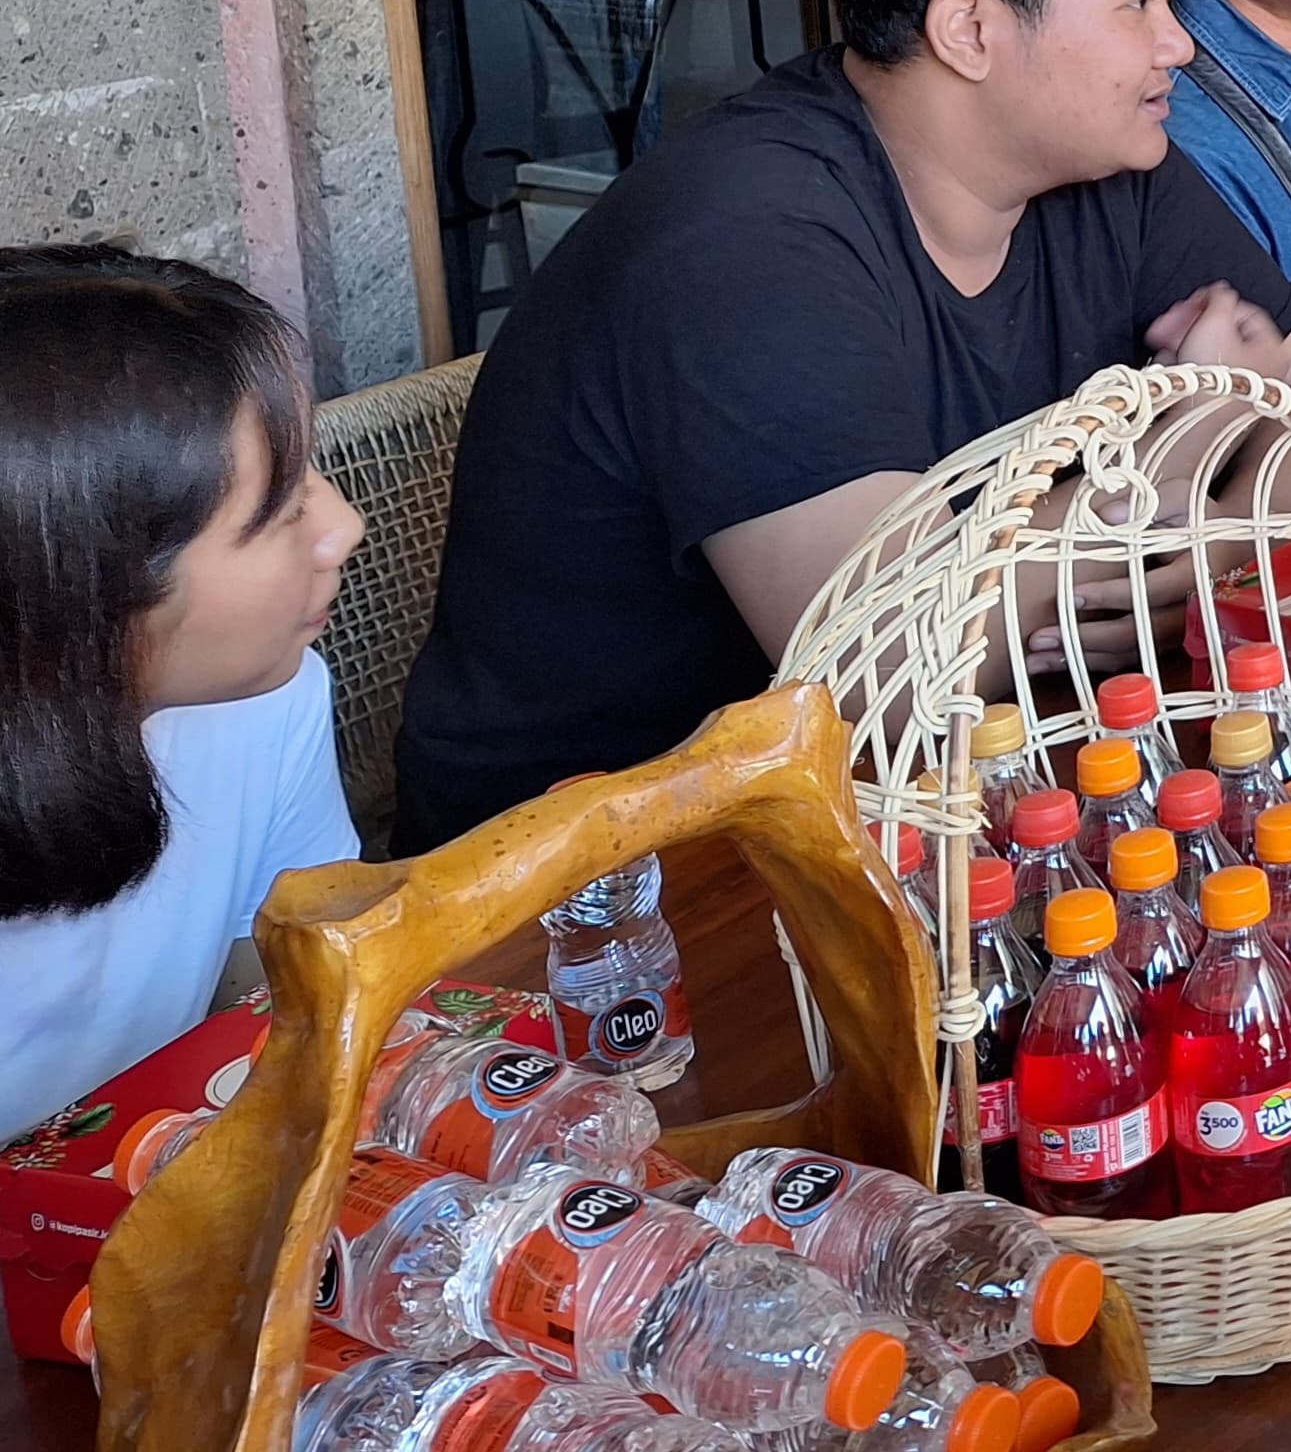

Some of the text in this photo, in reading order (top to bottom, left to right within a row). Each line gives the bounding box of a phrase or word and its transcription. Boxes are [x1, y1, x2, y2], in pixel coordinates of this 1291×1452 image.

[611, 1010, 657, 1043] Cleo
[490, 1055, 555, 1089] Cleo
[778, 1165, 836, 1208] Cleo
[565, 1188, 633, 1229] Cleo
